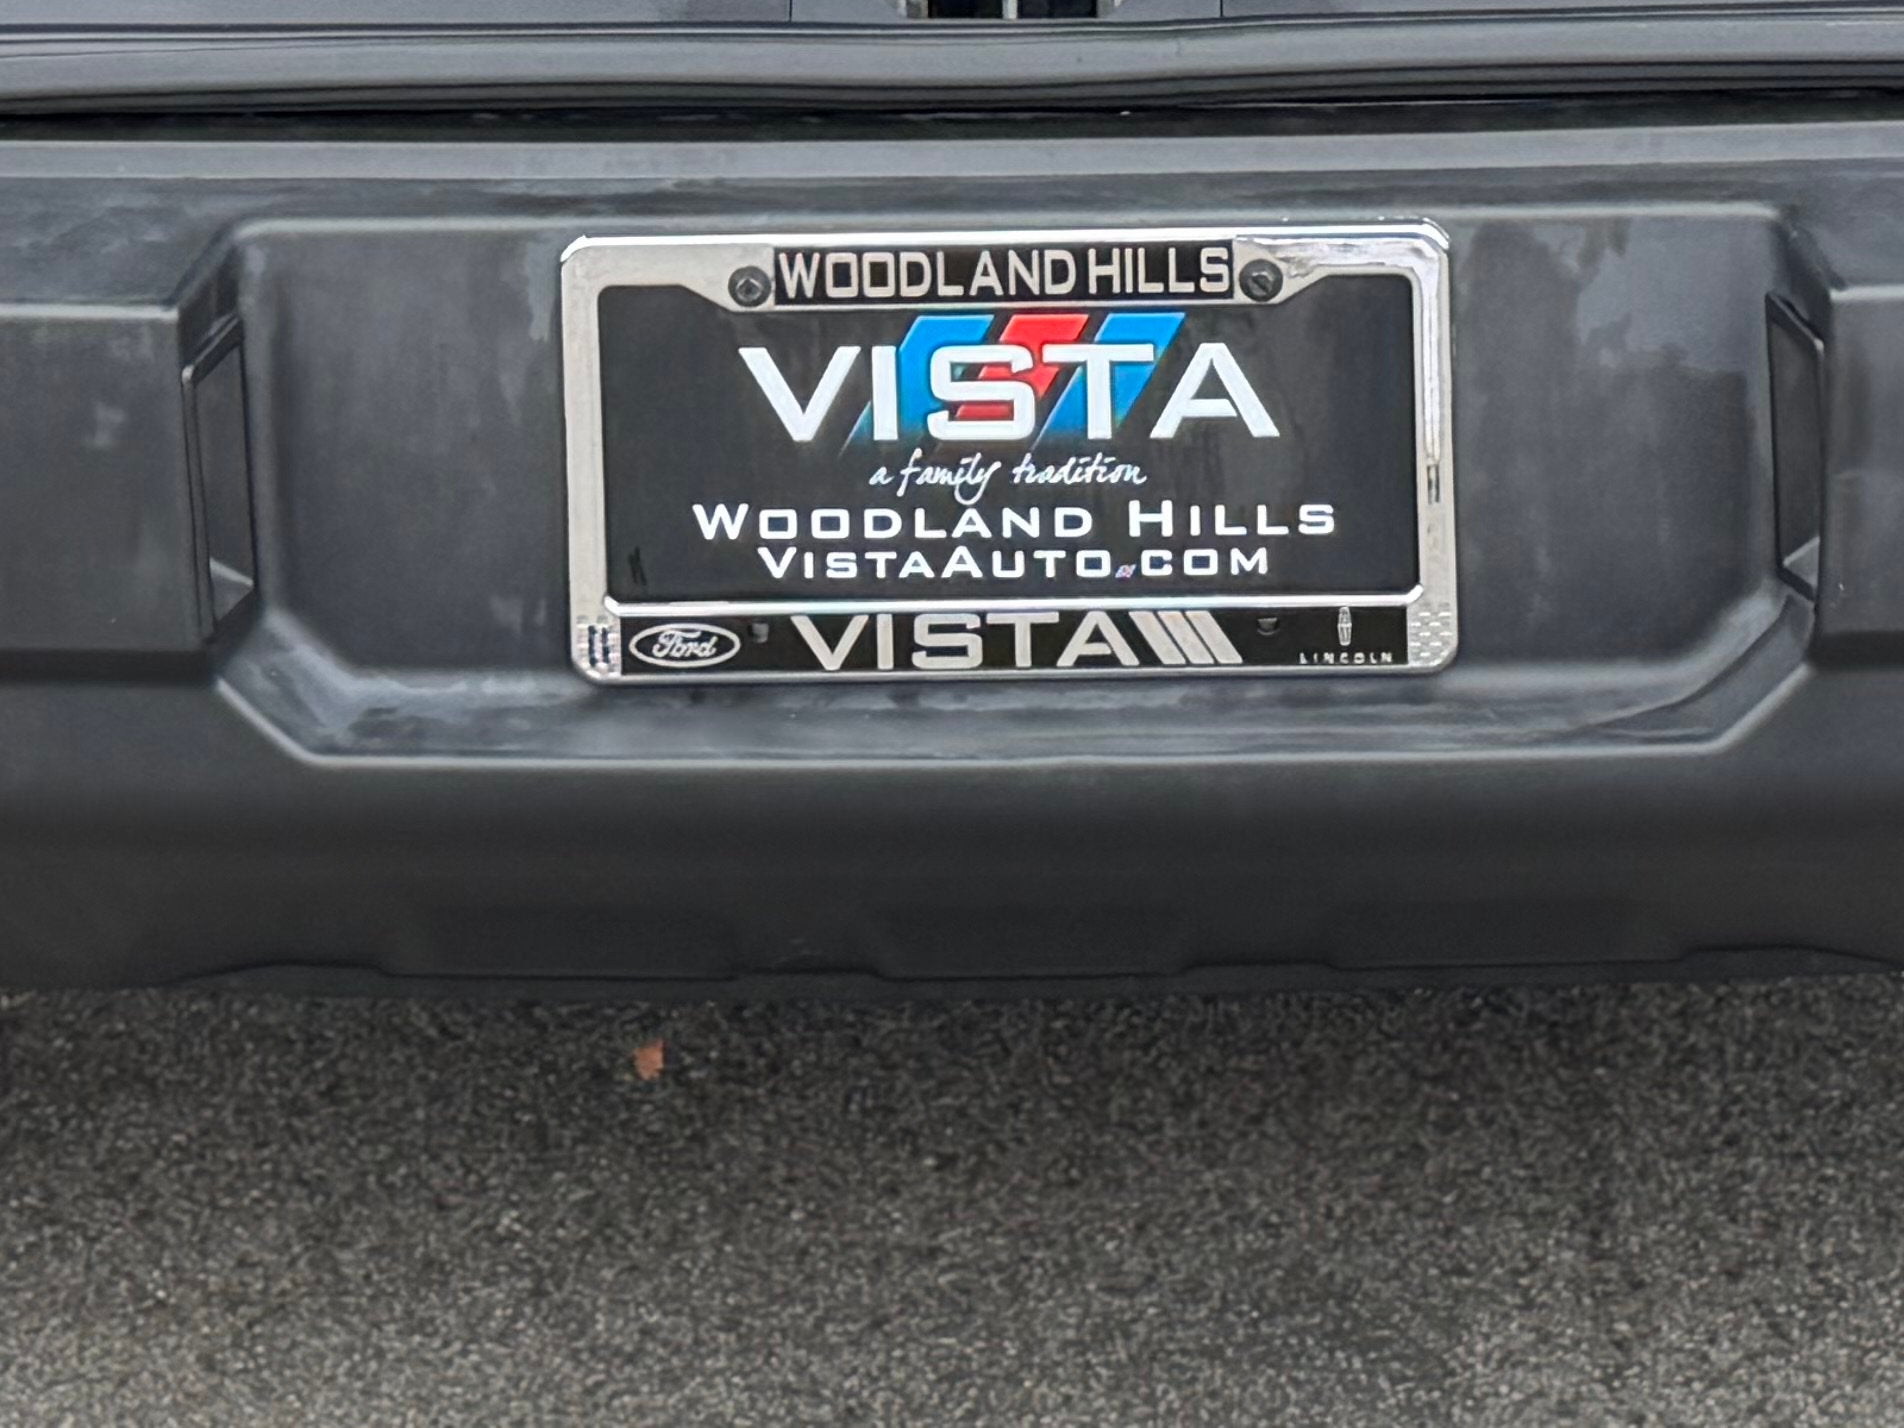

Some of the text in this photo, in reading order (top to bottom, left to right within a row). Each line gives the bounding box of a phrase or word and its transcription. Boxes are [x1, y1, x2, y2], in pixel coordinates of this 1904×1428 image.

[778, 247, 1231, 299] WOODLAND HILLS
[739, 342, 1280, 442] VISTA
[869, 448, 1147, 505] a family tradition
[693, 500, 1335, 540] WOODLAND HILLS
[652, 630, 718, 658] Ford
[791, 612, 1140, 670] VISTA
[1299, 651, 1393, 665] LINCOLN
